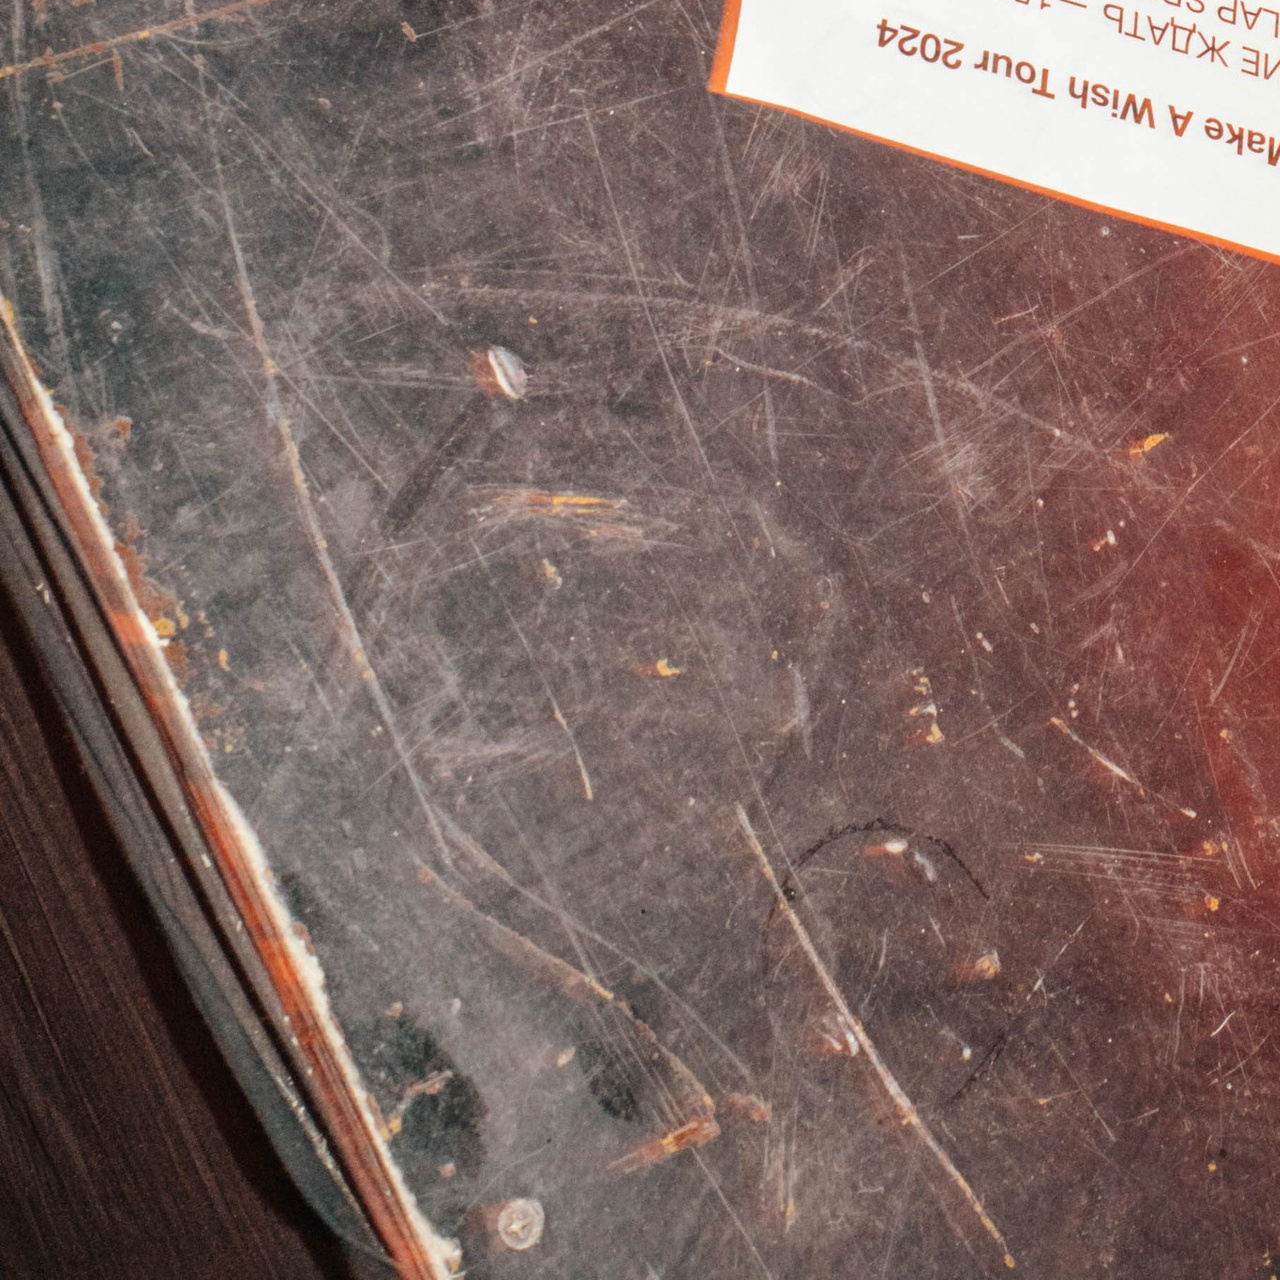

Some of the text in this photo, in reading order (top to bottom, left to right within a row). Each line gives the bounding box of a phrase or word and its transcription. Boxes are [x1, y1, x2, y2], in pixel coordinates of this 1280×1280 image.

[877, 19, 964, 69] 2024
[1104, 4, 1230, 67] ЖДАТЬ
[974, 50, 1055, 99] Tour
[1069, 76, 1155, 129] Wish
[1169, 105, 1193, 137] A
